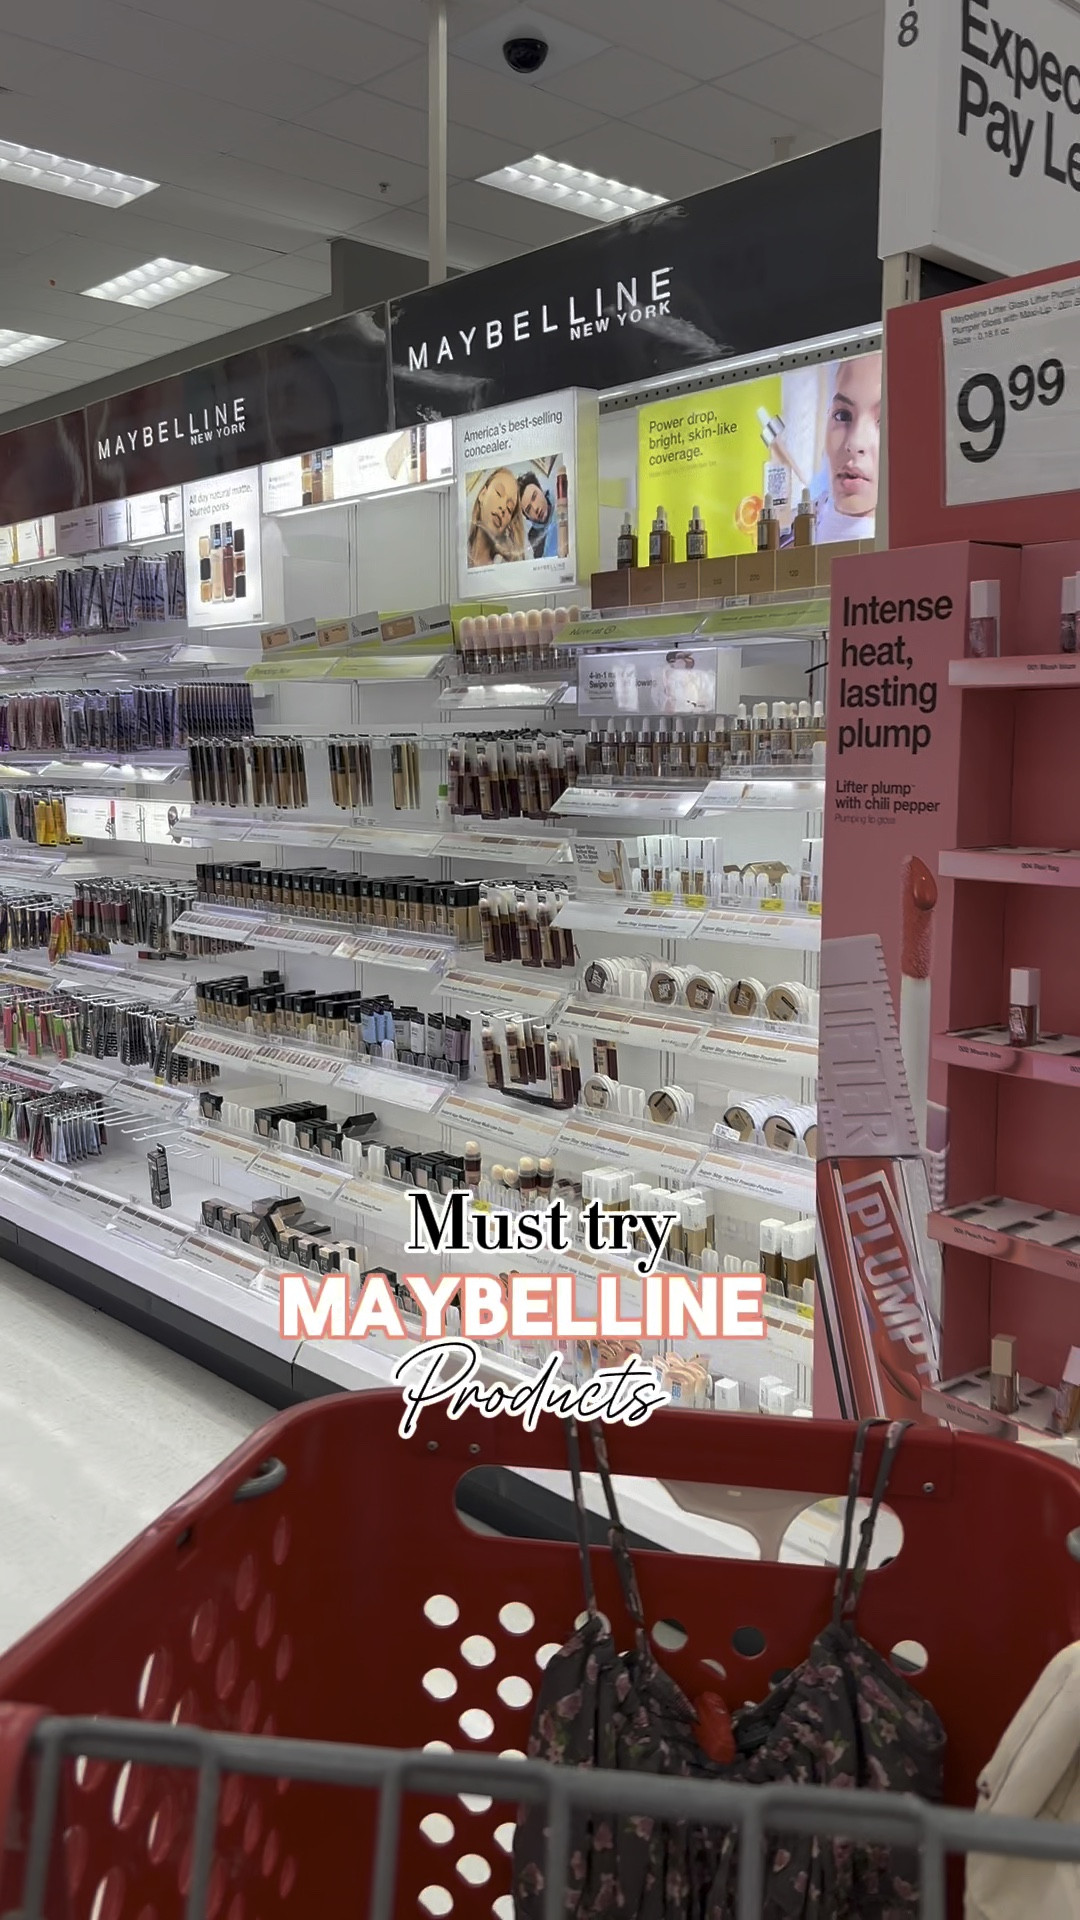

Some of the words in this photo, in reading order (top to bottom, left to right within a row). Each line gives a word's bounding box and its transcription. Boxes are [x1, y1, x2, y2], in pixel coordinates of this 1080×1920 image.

[898, 10, 919, 47] 8
[958, 65, 1034, 178] Pay
[408, 266, 674, 372] MAYBELLINE
[569, 317, 610, 341] NEW
[615, 300, 671, 327] YORK
[98, 397, 246, 461] MAYBELLINE
[189, 430, 213, 446] NEW
[216, 421, 247, 438] YORK
[463, 423, 507, 443] America's
[508, 410, 563, 434] best-selling
[648, 430, 686, 450] bright,
[688, 422, 738, 443] skin-like
[649, 417, 685, 434] Power
[686, 409, 718, 426] drop,
[648, 446, 704, 466] coverage.
[189, 503, 211, 517] blurred
[198, 492, 209, 504] day
[842, 594, 954, 627] Intense
[840, 635, 914, 671] heat,
[588, 680, 608, 690] Swipe
[839, 675, 938, 714] lasting
[837, 717, 932, 755] plump
[836, 779, 869, 793] Lifter
[835, 796, 861, 809] with
[864, 797, 890, 810] chili
[893, 800, 941, 814] pepper
